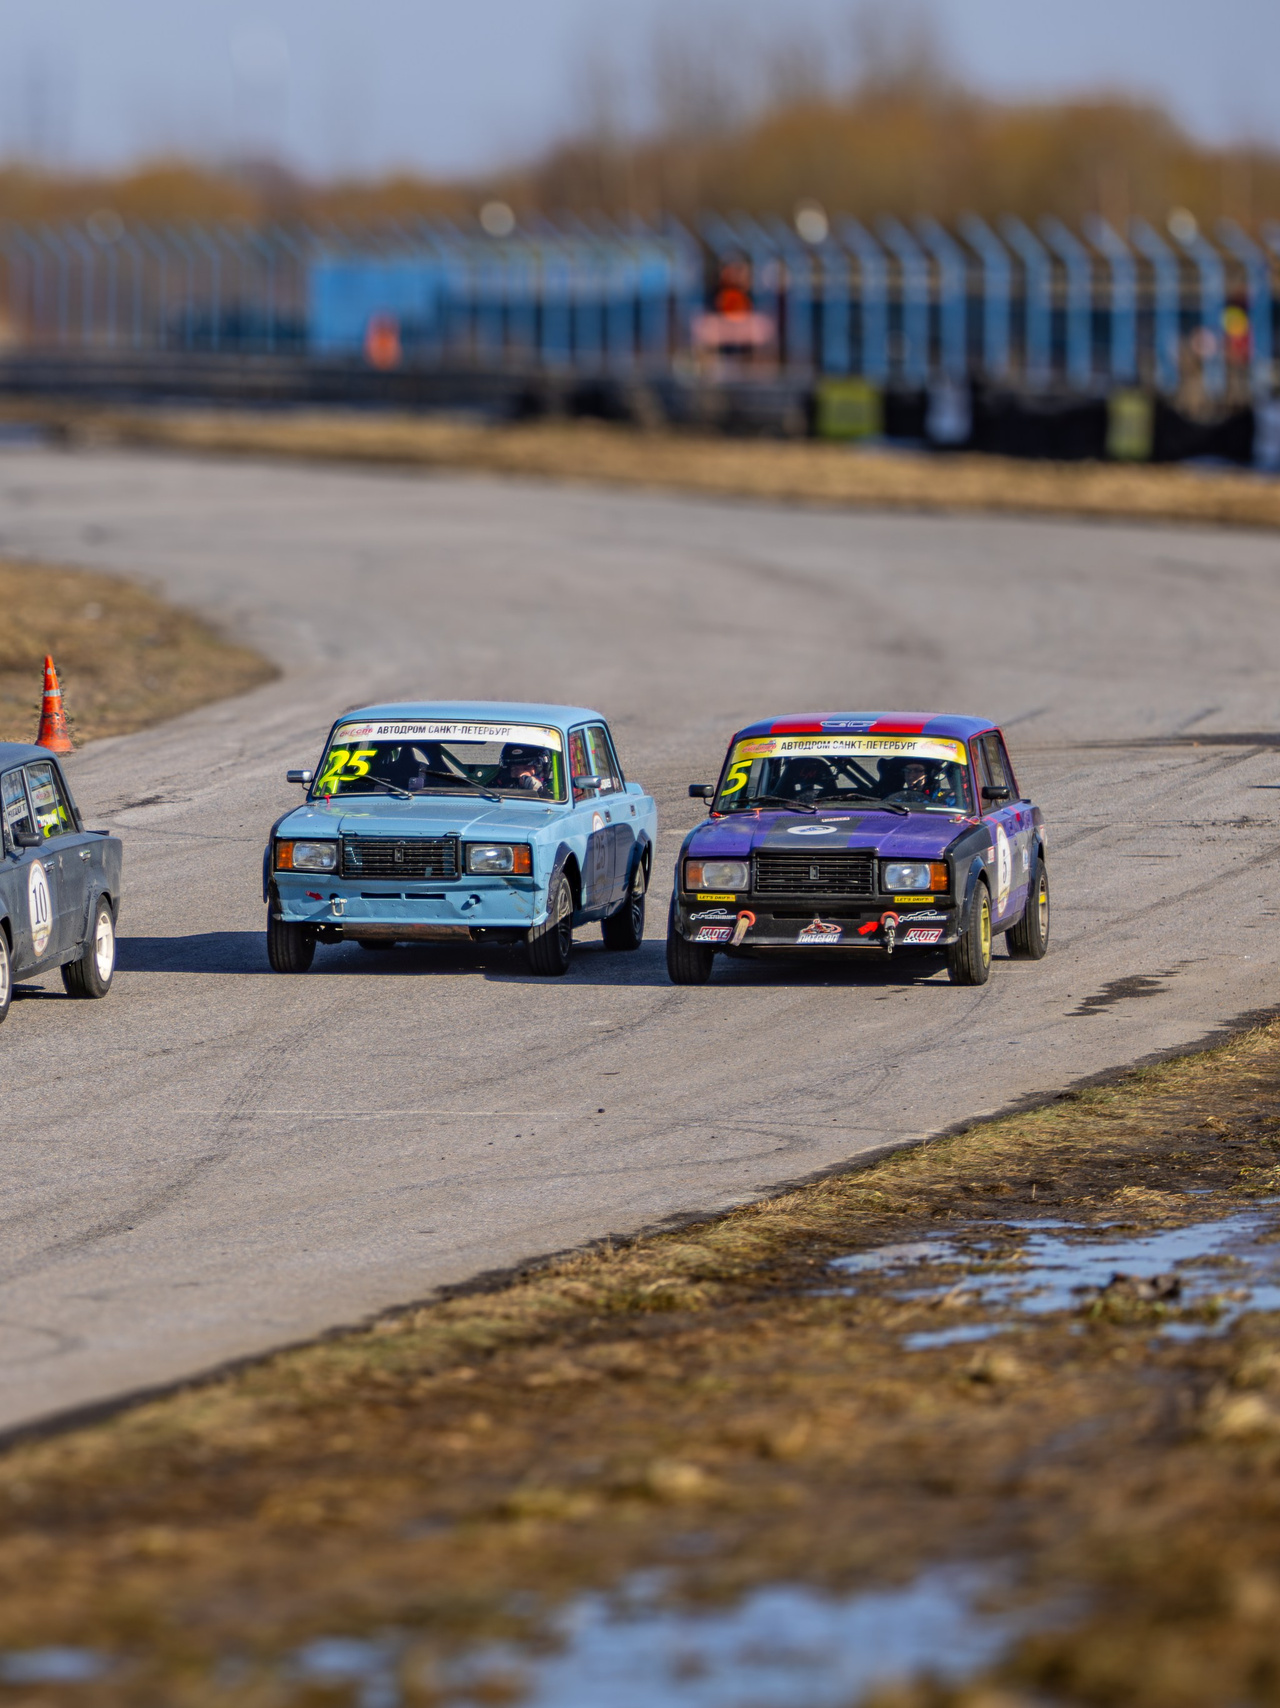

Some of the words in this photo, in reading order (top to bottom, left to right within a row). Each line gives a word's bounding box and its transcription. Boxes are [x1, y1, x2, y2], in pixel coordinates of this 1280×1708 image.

[376, 725, 426, 735] АВТОДРОМ
[428, 725, 512, 737] САНКТ-ПЕТЕРБУРГ
[780, 740, 831, 751] АВТОДРОМ
[833, 739, 918, 751] САНКТ-ПЕТЕРБУРГ
[318, 749, 378, 784] 25
[721, 759, 753, 797] 5
[596, 834, 605, 871] 25
[32, 881, 48, 925] 10
[701, 928, 730, 938] KLOTZ
[908, 930, 940, 940] KLOTZ
